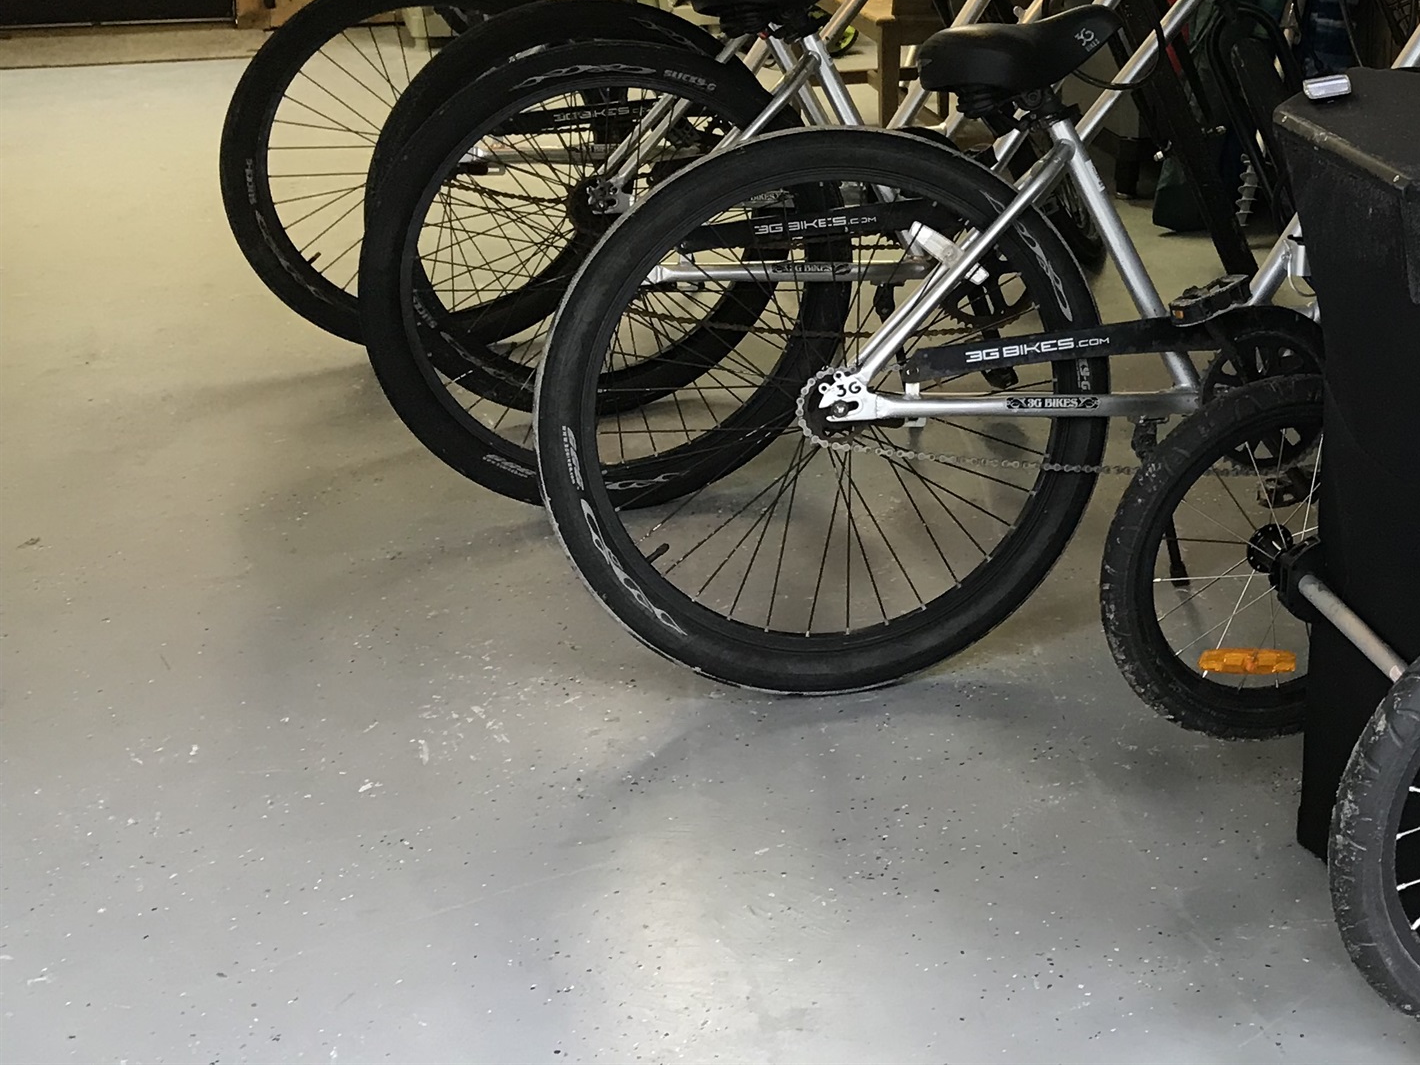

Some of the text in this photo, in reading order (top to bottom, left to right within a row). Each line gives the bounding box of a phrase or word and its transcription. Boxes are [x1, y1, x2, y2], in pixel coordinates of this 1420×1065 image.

[965, 348, 1000, 364] 3G
[836, 380, 862, 398] 3G
[1027, 397, 1079, 408] 3G BIKES
